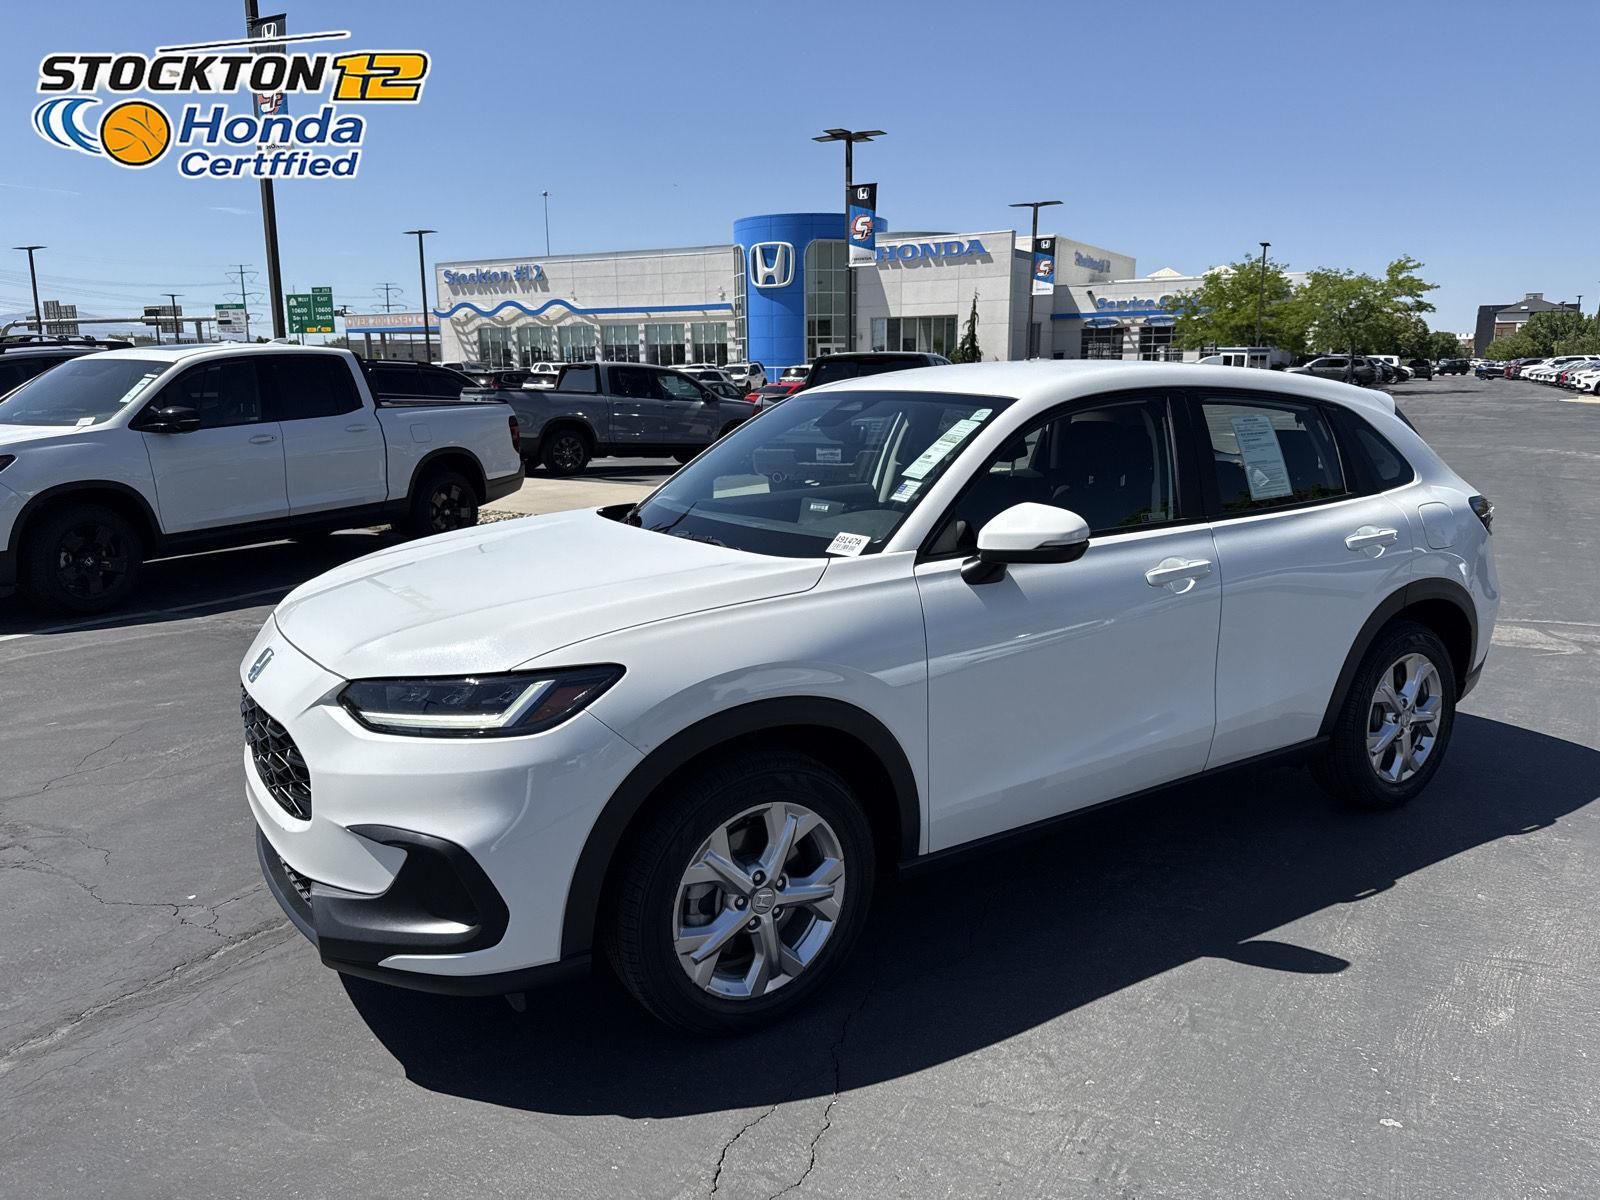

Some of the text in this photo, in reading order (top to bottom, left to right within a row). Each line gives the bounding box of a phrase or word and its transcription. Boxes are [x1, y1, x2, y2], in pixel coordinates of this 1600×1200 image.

[875, 239, 988, 262] HONDA
[443, 268, 510, 285] Stockton
[1096, 296, 1156, 309] Service
